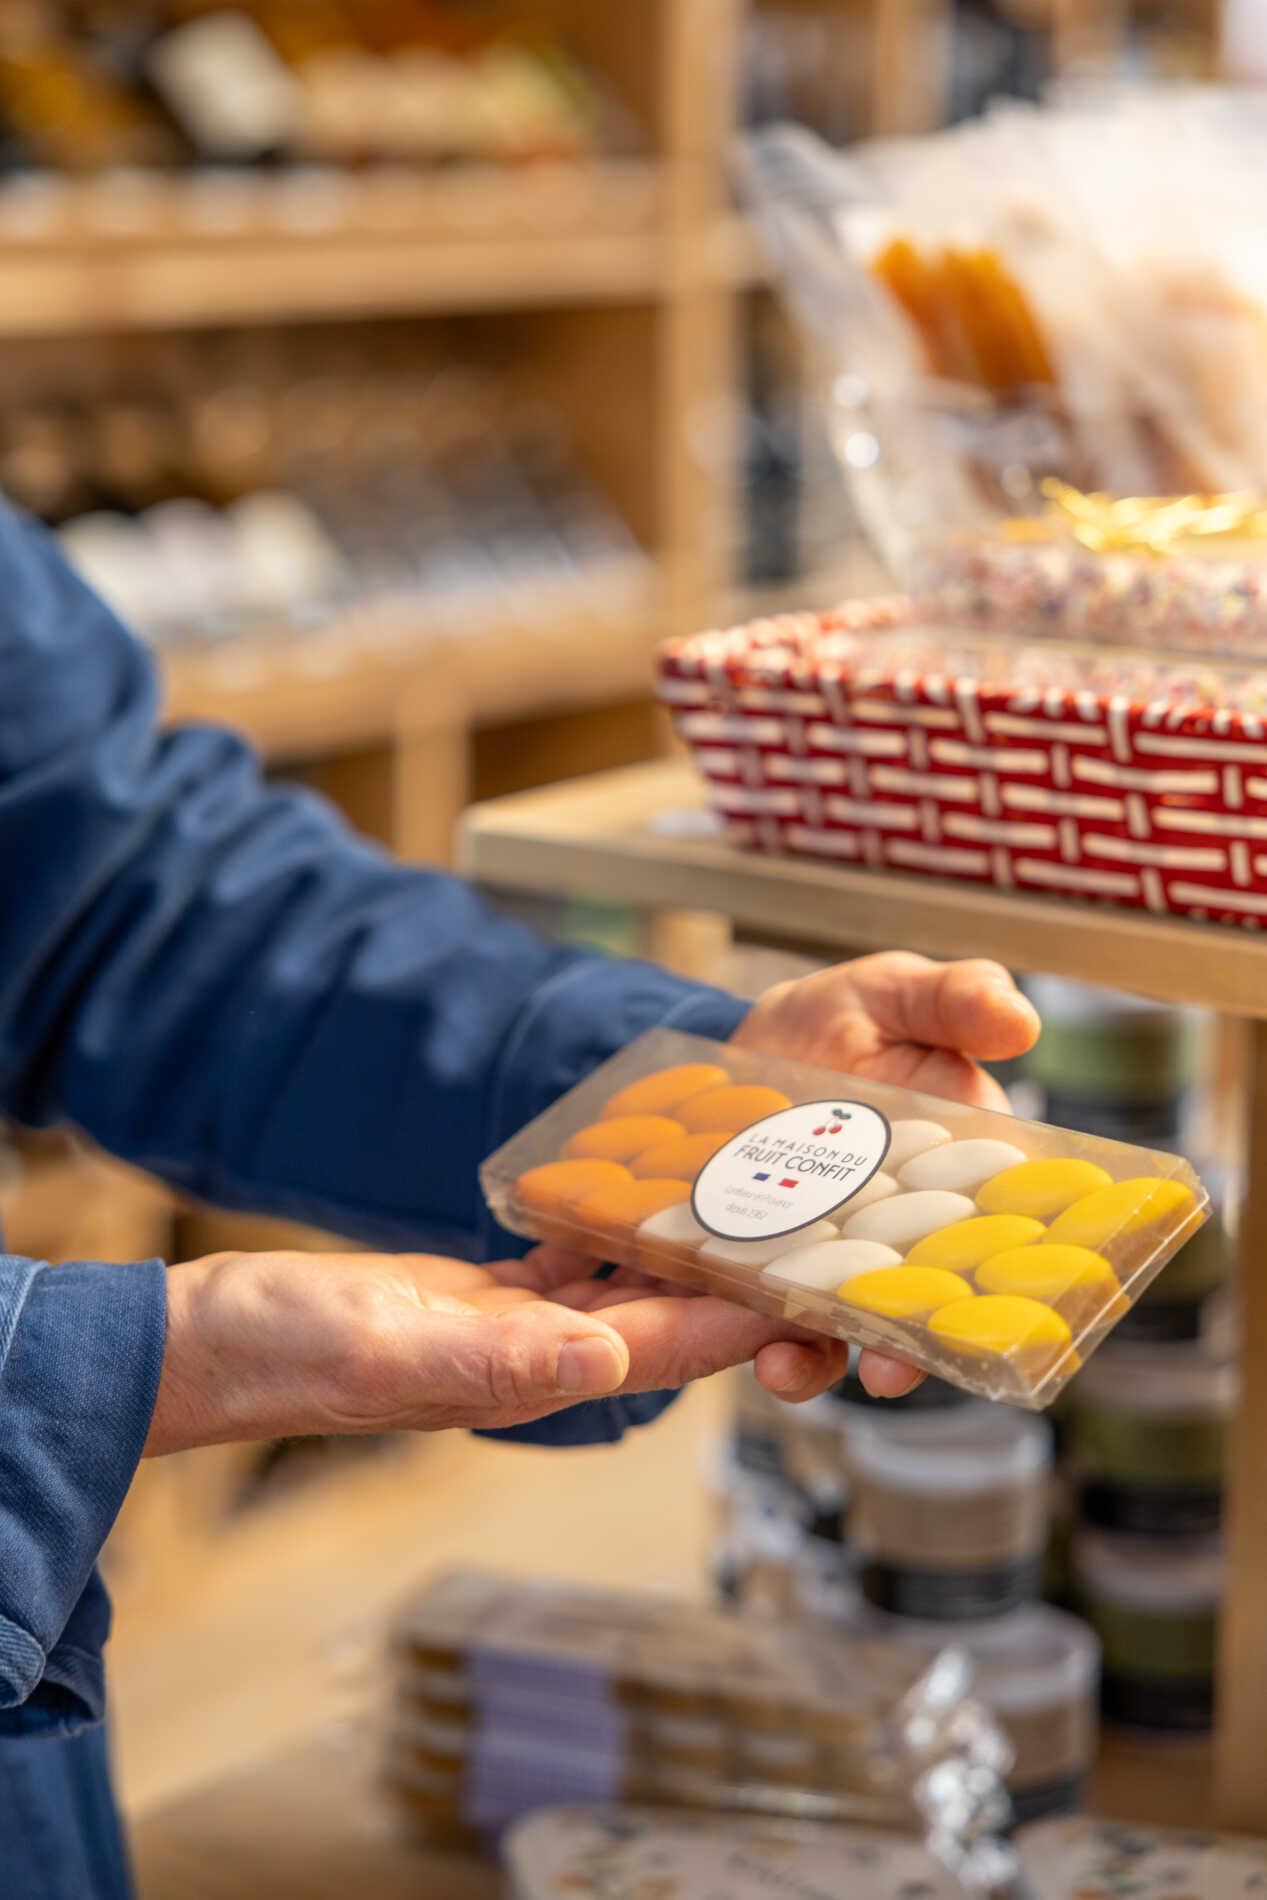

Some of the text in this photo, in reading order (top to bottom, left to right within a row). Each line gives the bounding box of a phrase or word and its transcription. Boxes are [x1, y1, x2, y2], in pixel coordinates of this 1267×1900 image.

[734, 1144, 855, 1181] FRUIT CONFIT
[750, 1133, 868, 1166] LA MAISON DU
